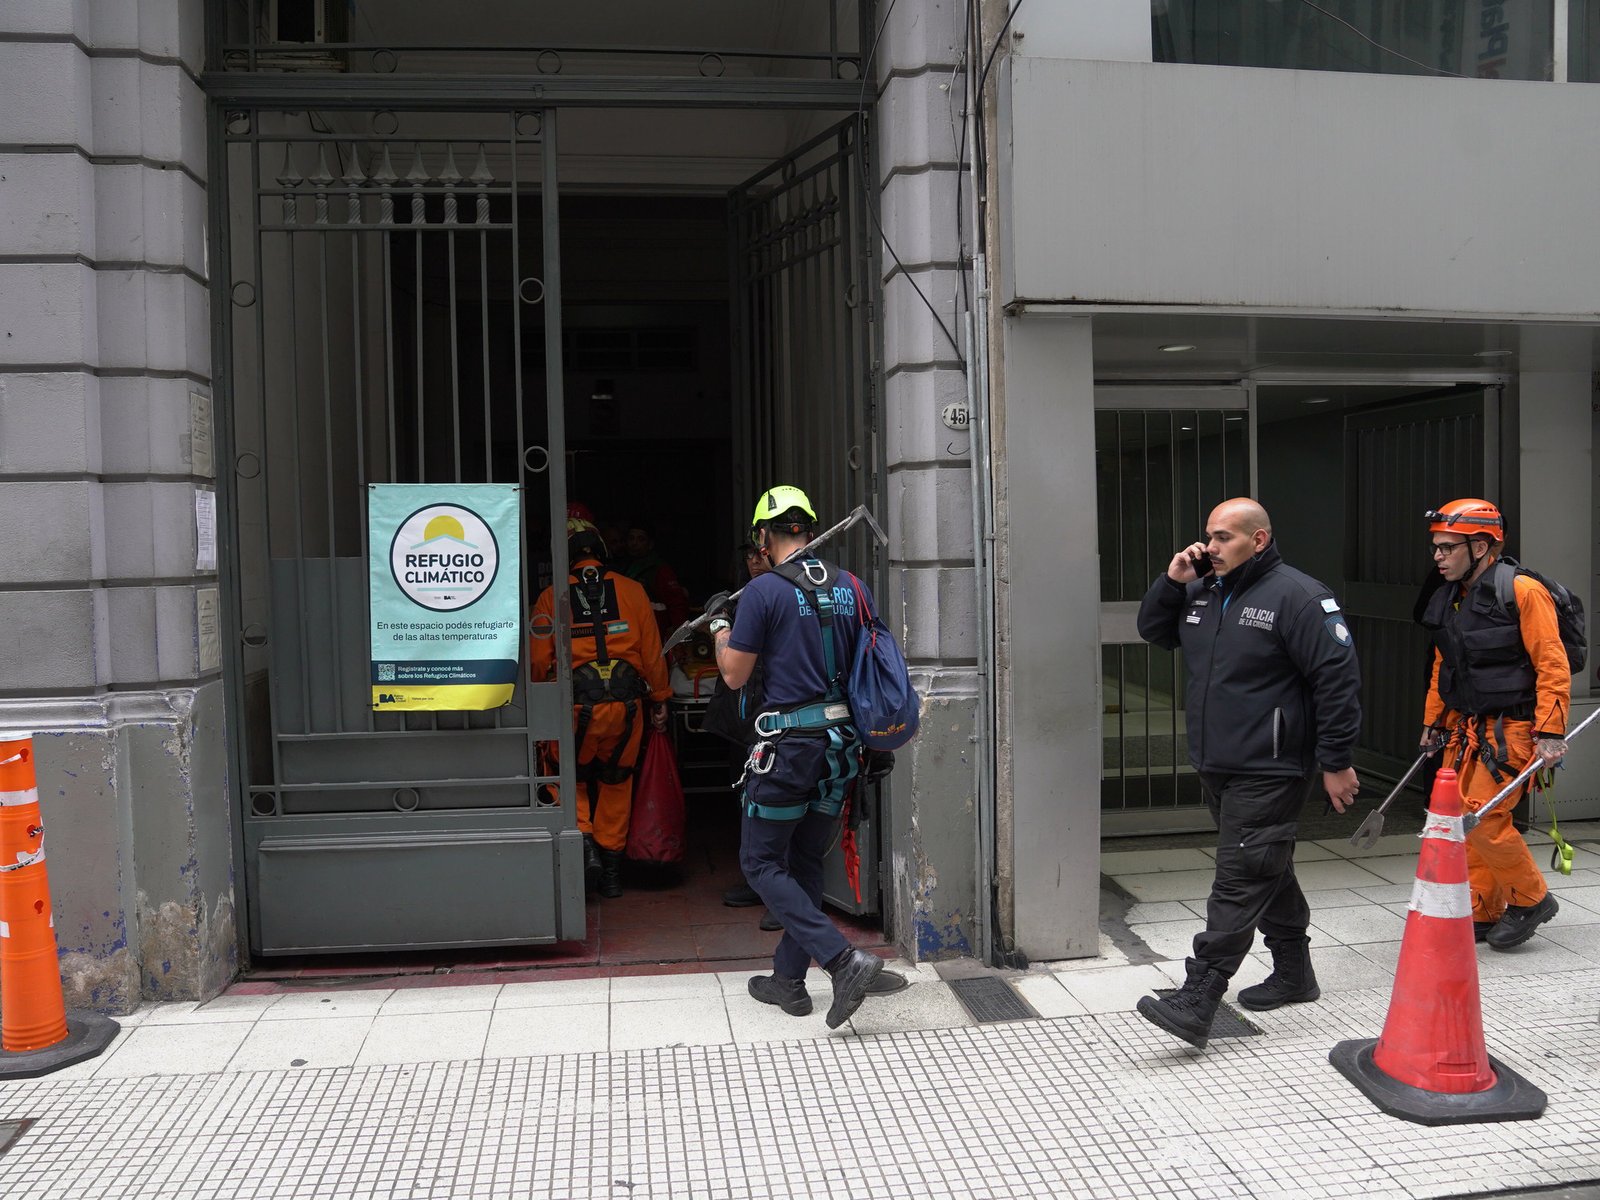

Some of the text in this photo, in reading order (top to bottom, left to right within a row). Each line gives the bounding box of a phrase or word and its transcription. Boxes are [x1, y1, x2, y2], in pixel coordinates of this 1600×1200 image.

[405, 554, 484, 567] REFUGIO
[405, 568, 485, 583] CLIMÁTICO
[799, 605, 812, 616] DE
[1240, 606, 1275, 624] POLICIA
[377, 620, 514, 632] En este espacio podés refugiarte
[1238, 617, 1273, 632] DE LA CIUDAD
[393, 632, 498, 642] de las altas temperaturas
[423, 672, 448, 680] Refugios
[379, 693, 395, 703] BA
